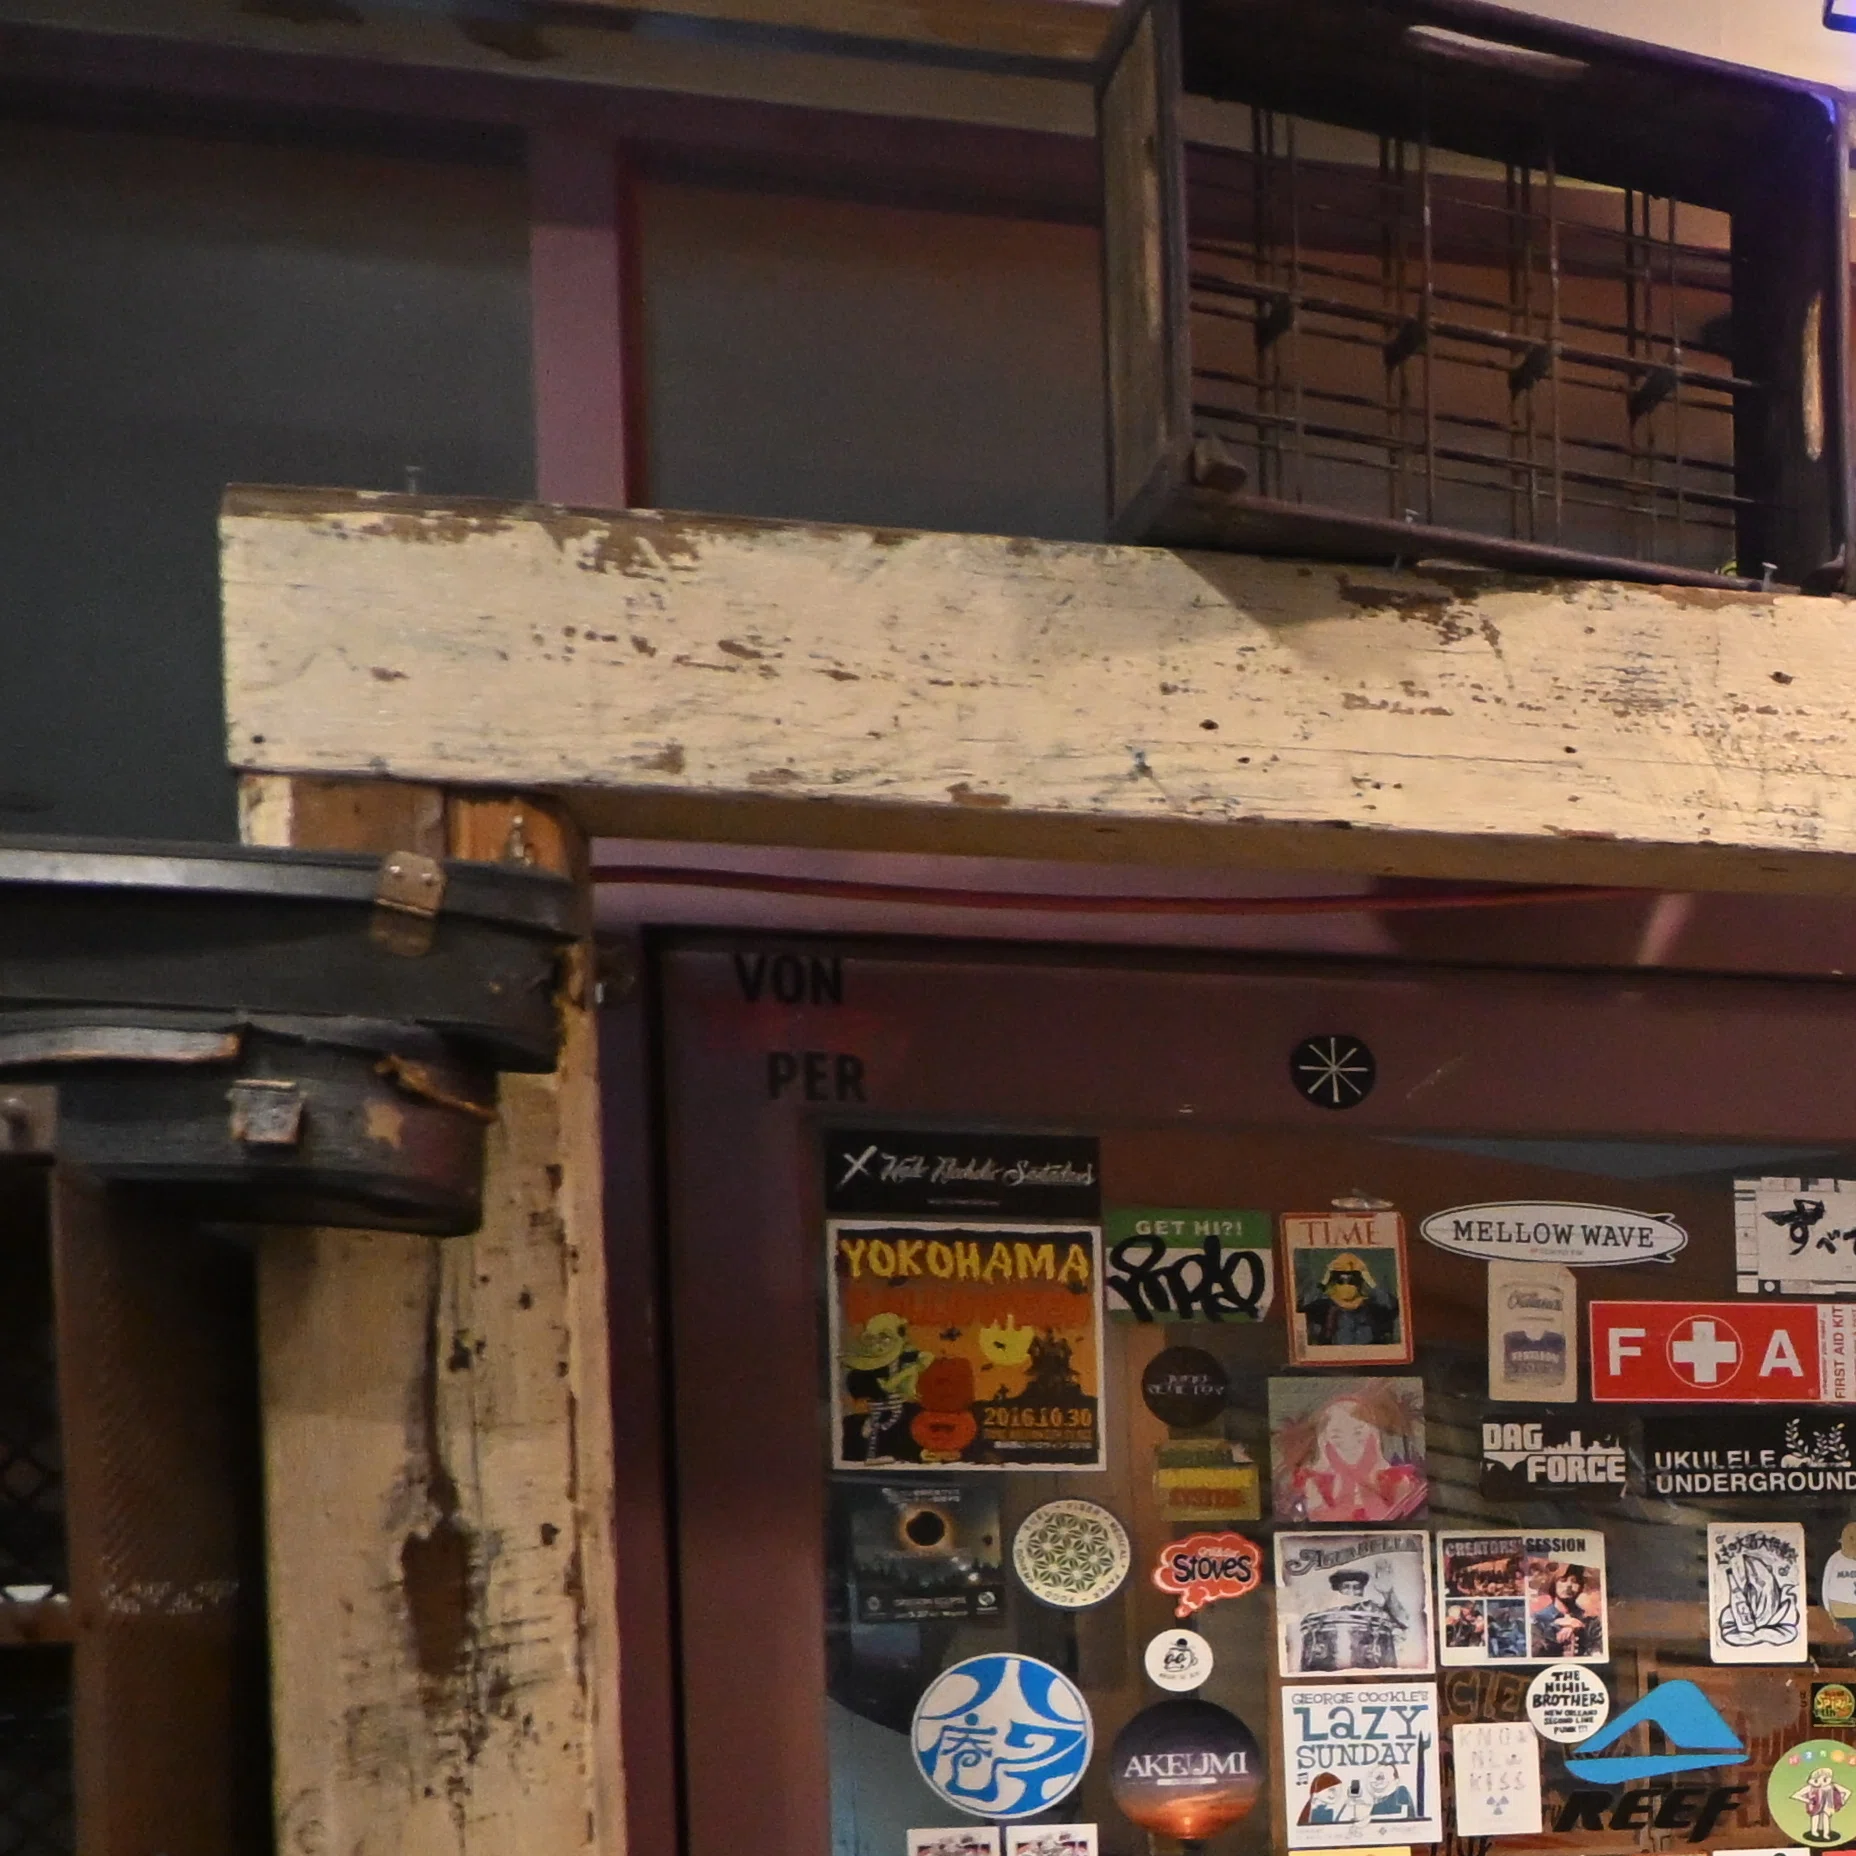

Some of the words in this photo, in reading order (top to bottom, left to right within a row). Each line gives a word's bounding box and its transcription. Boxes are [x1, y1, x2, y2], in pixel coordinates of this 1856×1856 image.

[731, 953, 844, 1004] VON
[766, 1051, 867, 1101] PER
[1299, 1220, 1380, 1246] TIME
[1452, 1220, 1578, 1248] MELLOW
[1581, 1223, 1654, 1249] WAVE
[841, 1238, 1090, 1283] YOKOHAMA
[1608, 1328, 1646, 1376] F
[1758, 1328, 1804, 1378] A
[1482, 1424, 1542, 1451] DAG
[1526, 1454, 1626, 1483] FORCE
[1654, 1449, 1777, 1471] UKULELE
[1551, 1670, 1583, 1682] THE
[1532, 1691, 1605, 1708] BROTHERS
[1296, 1742, 1414, 1769] SUNDAY
[1552, 1785, 1750, 1843] REEF
